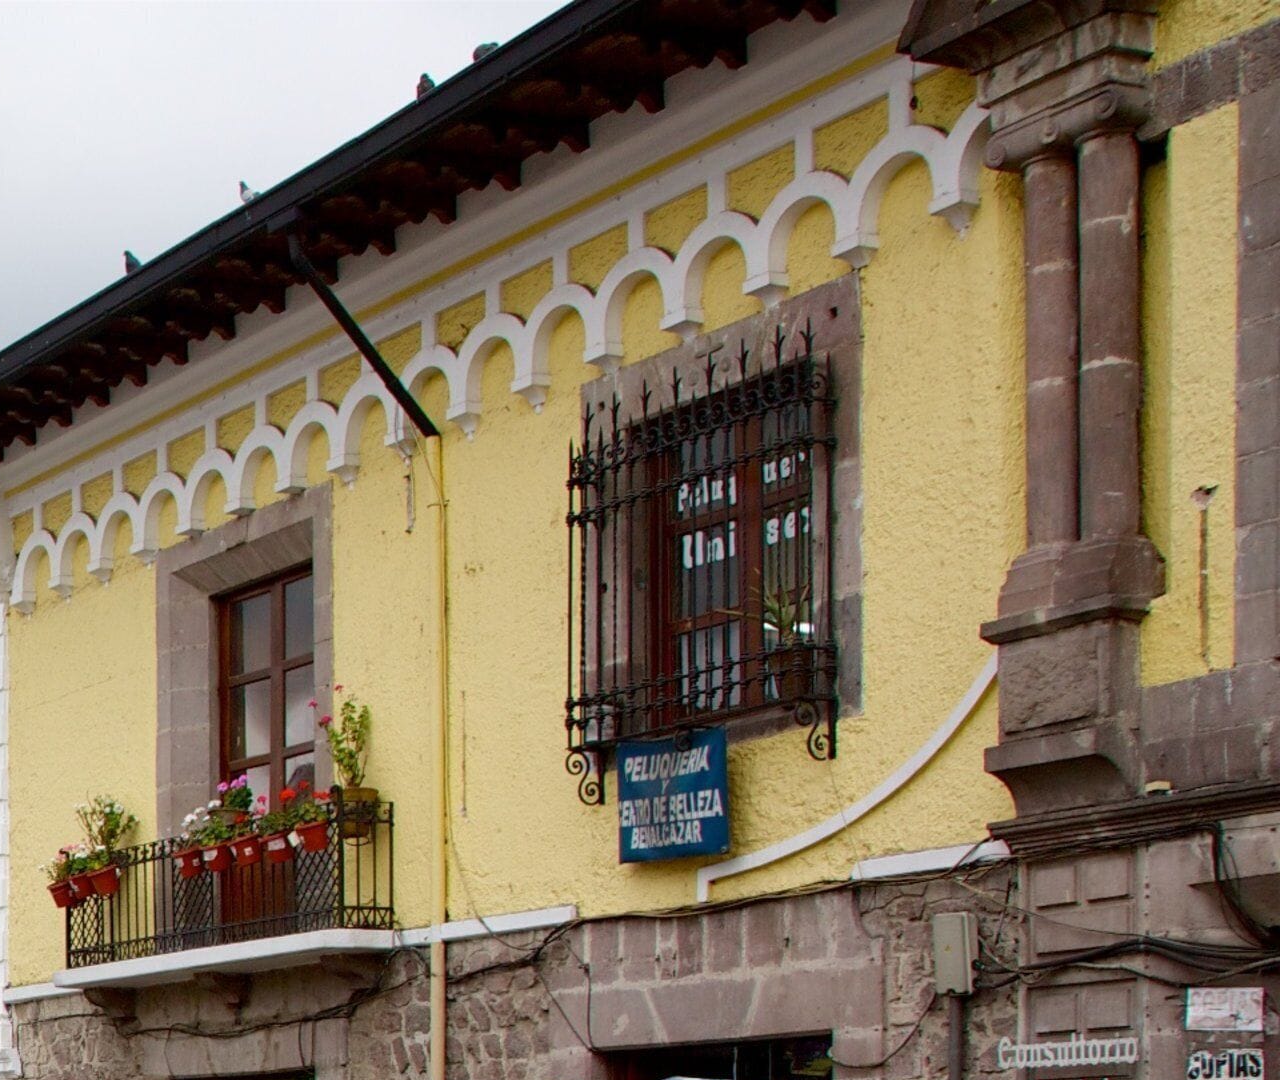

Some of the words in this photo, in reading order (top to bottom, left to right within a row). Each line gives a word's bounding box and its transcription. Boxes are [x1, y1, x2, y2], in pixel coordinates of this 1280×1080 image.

[624, 745, 709, 782] PELUQUERIA
[661, 780, 669, 794] Y
[653, 796, 667, 823] DE
[669, 788, 723, 821] BELLEZA
[998, 1033, 1139, 1068] Consultorio
